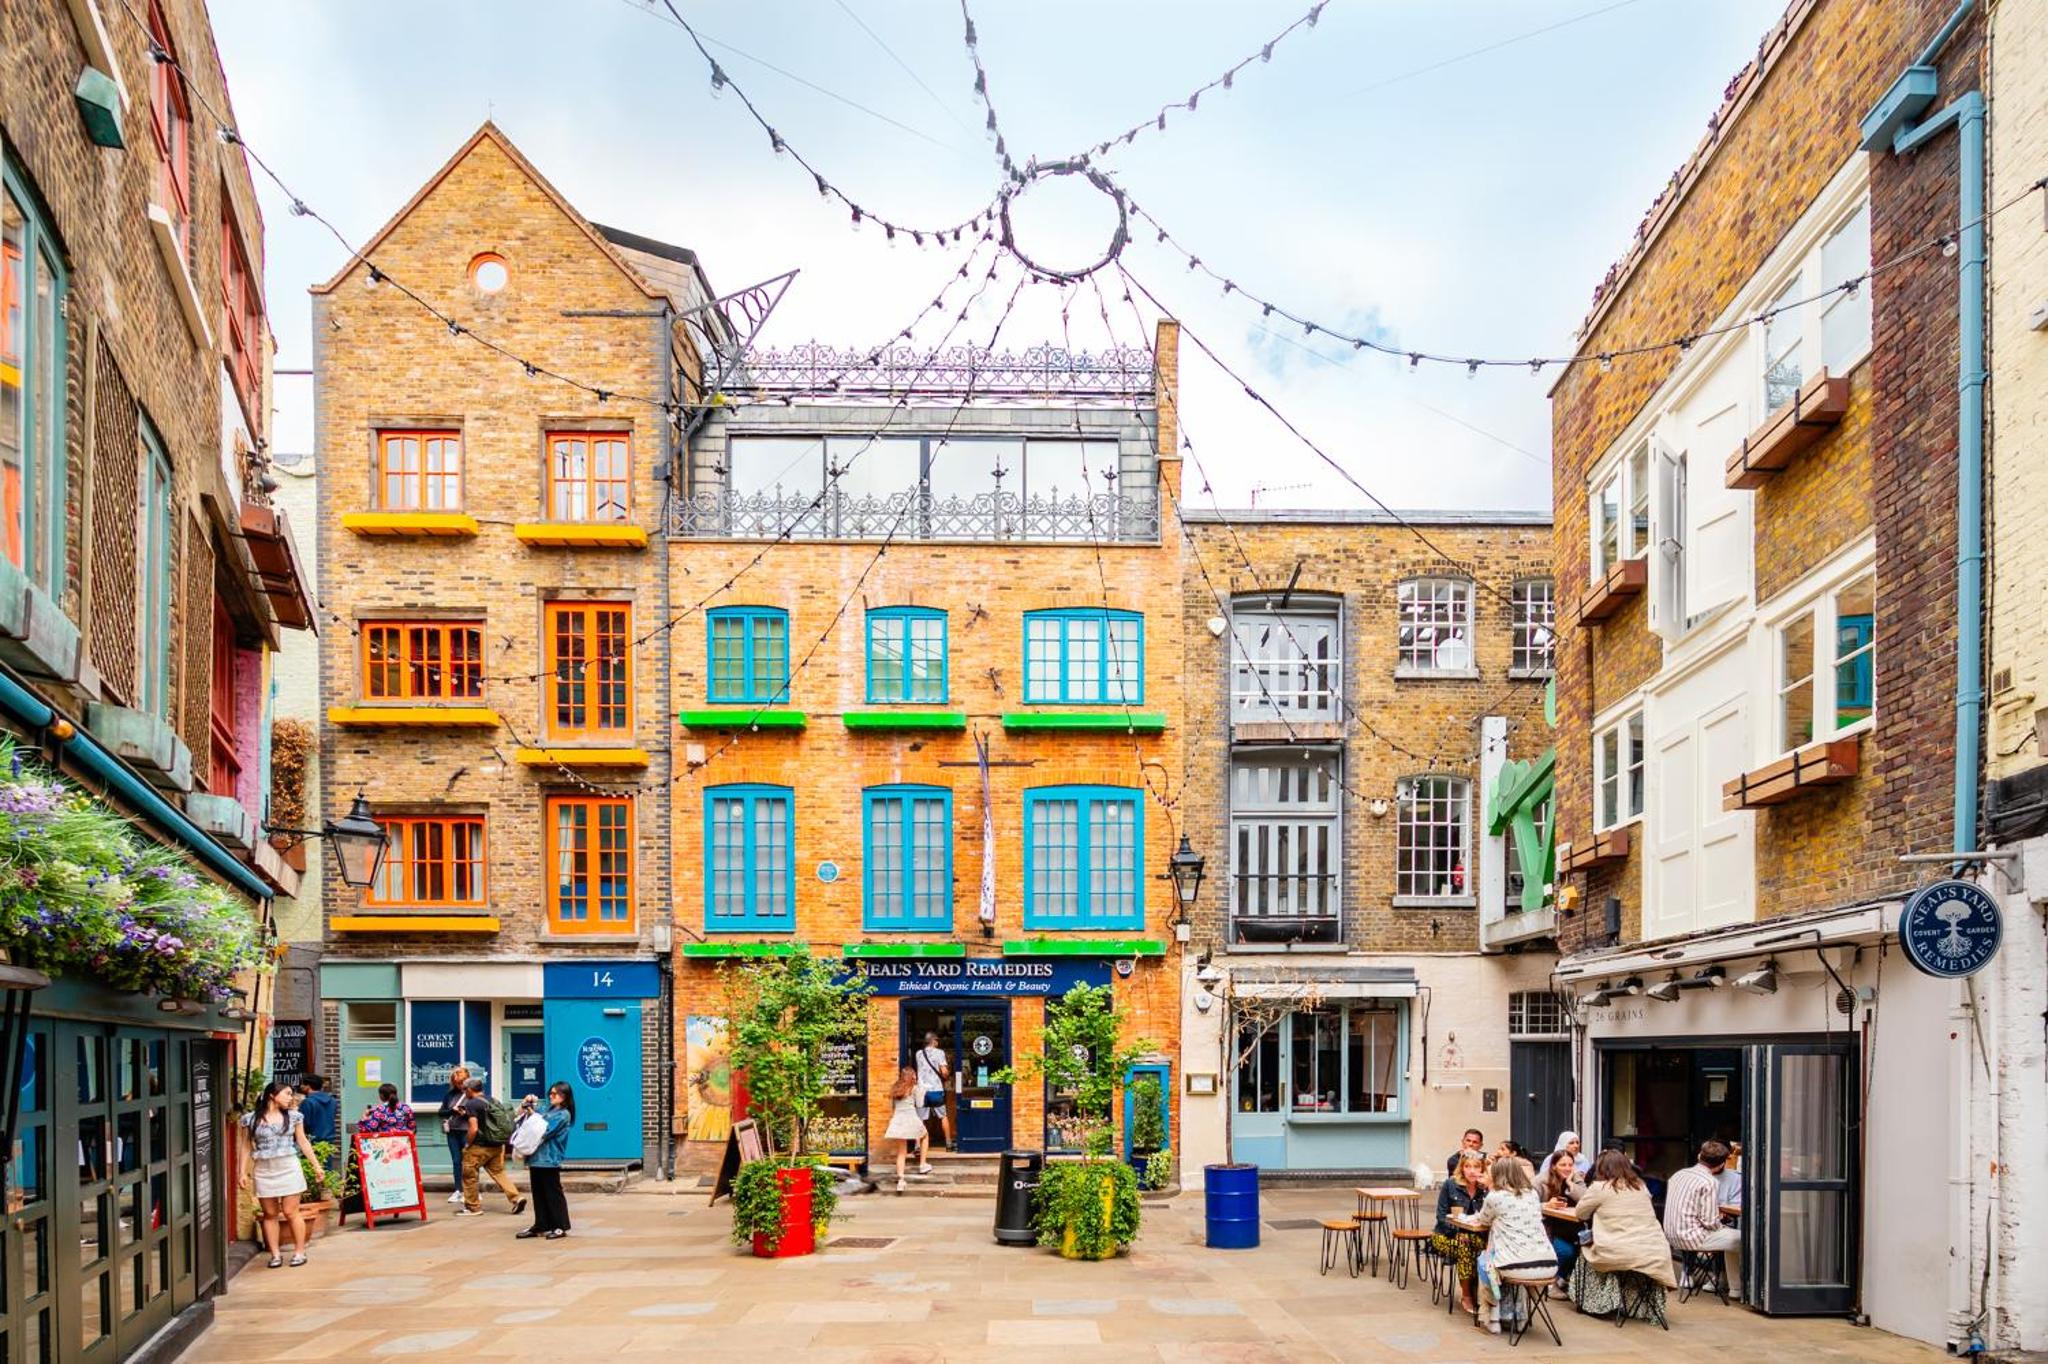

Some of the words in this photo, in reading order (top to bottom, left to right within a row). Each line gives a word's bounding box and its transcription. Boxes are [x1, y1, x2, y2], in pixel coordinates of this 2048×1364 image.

[1914, 887, 1957, 925] NEAL'S
[1961, 888, 1994, 923] YARD
[1913, 929, 1941, 937] COVENT
[1966, 926, 1995, 934] GARDEN
[1916, 938, 1993, 970] REMEDIES
[856, 963, 912, 976] NEAL'S
[915, 962, 961, 976] YARD
[966, 962, 1053, 976] REMEDIES
[593, 971, 614, 987] 14
[899, 981, 932, 991] Ethical
[933, 981, 970, 992] Organic
[971, 981, 1003, 991] Health
[1004, 981, 1017, 991] &
[1018, 981, 1051, 992] Beauty
[1607, 1009, 1644, 1021] GRAINS
[417, 1033, 454, 1041] COVENT
